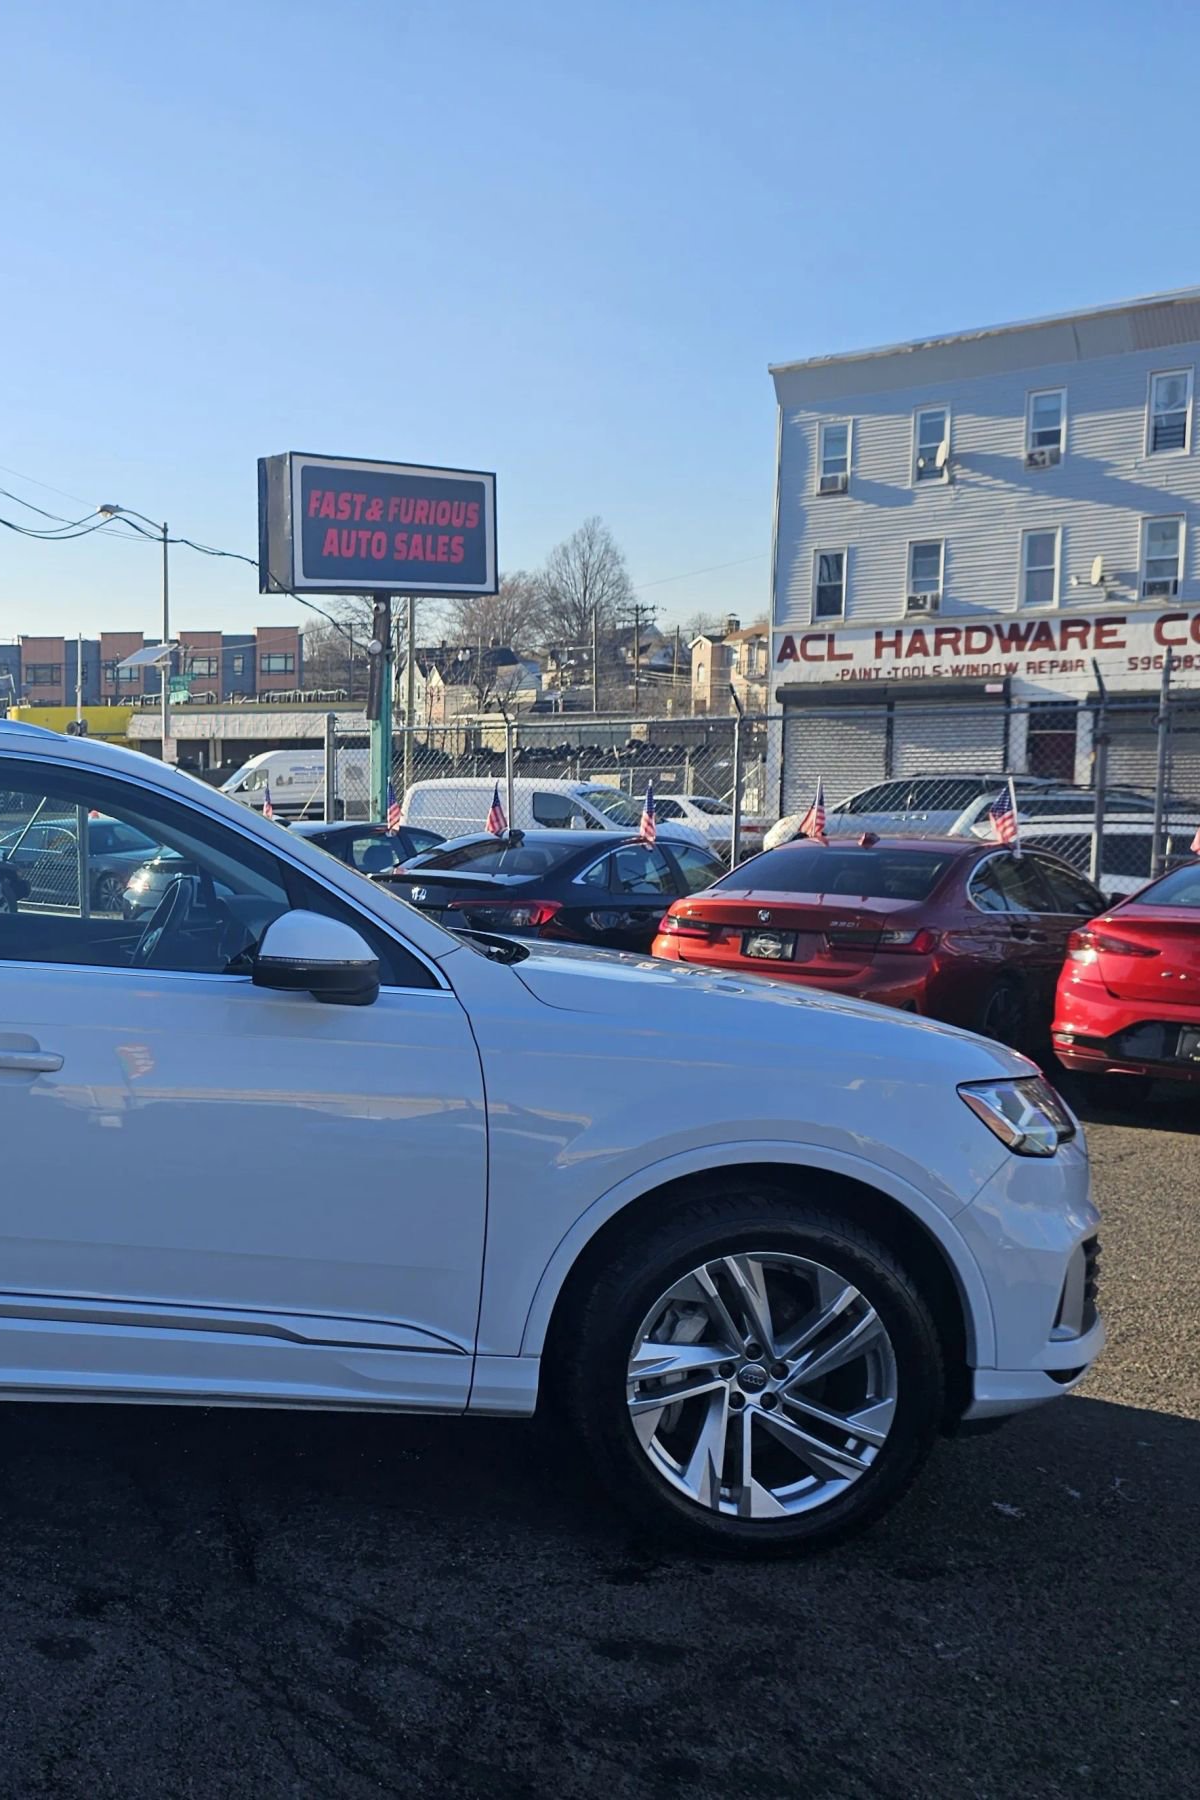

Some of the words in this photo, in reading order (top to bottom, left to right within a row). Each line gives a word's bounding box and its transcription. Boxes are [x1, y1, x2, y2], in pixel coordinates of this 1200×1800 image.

[308, 489, 367, 521] FAST
[365, 498, 384, 521] &
[388, 496, 480, 528] FURIOUS
[322, 528, 388, 560] AUTO
[393, 532, 465, 564] SALES
[776, 633, 853, 663] ACL
[874, 616, 1127, 659] HARDWARE
[1026, 659, 1086, 674] REPAIR
